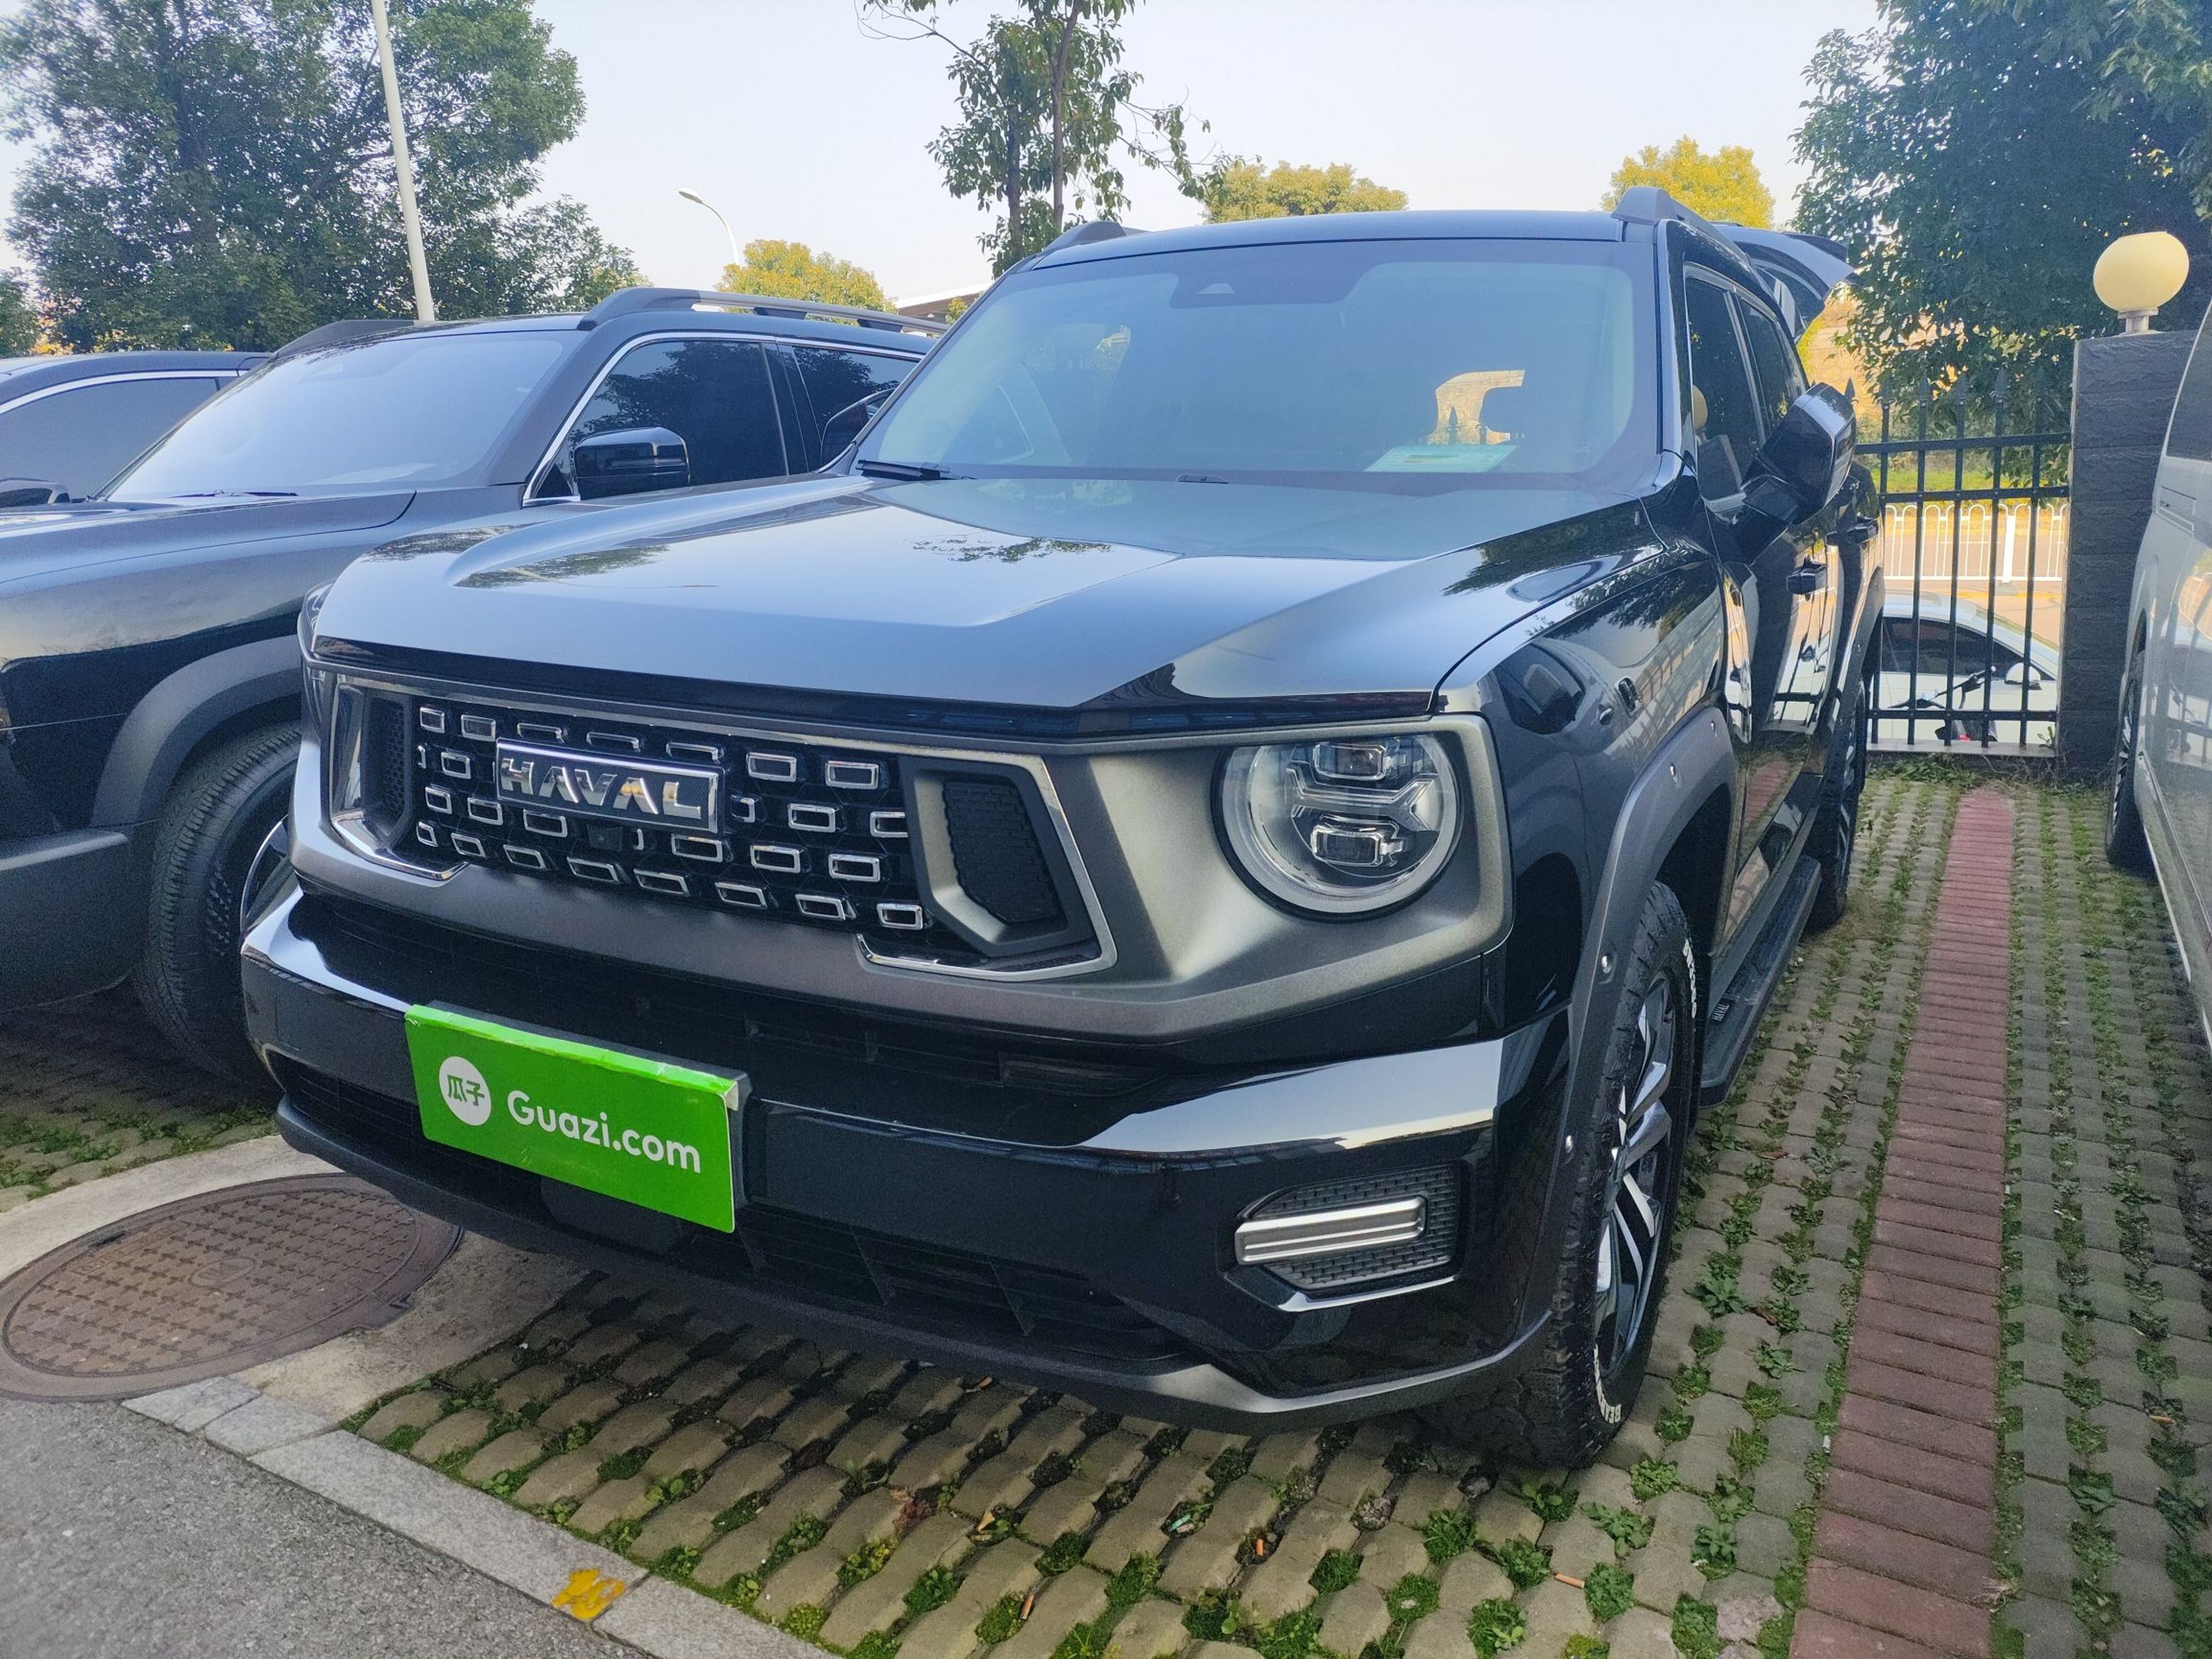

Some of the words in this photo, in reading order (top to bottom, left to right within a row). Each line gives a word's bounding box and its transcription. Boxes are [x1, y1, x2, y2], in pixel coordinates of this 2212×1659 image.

[501, 757, 701, 820] HAVAL
[446, 1074, 485, 1107] 瓜子
[507, 1090, 701, 1173] Guazi.com
